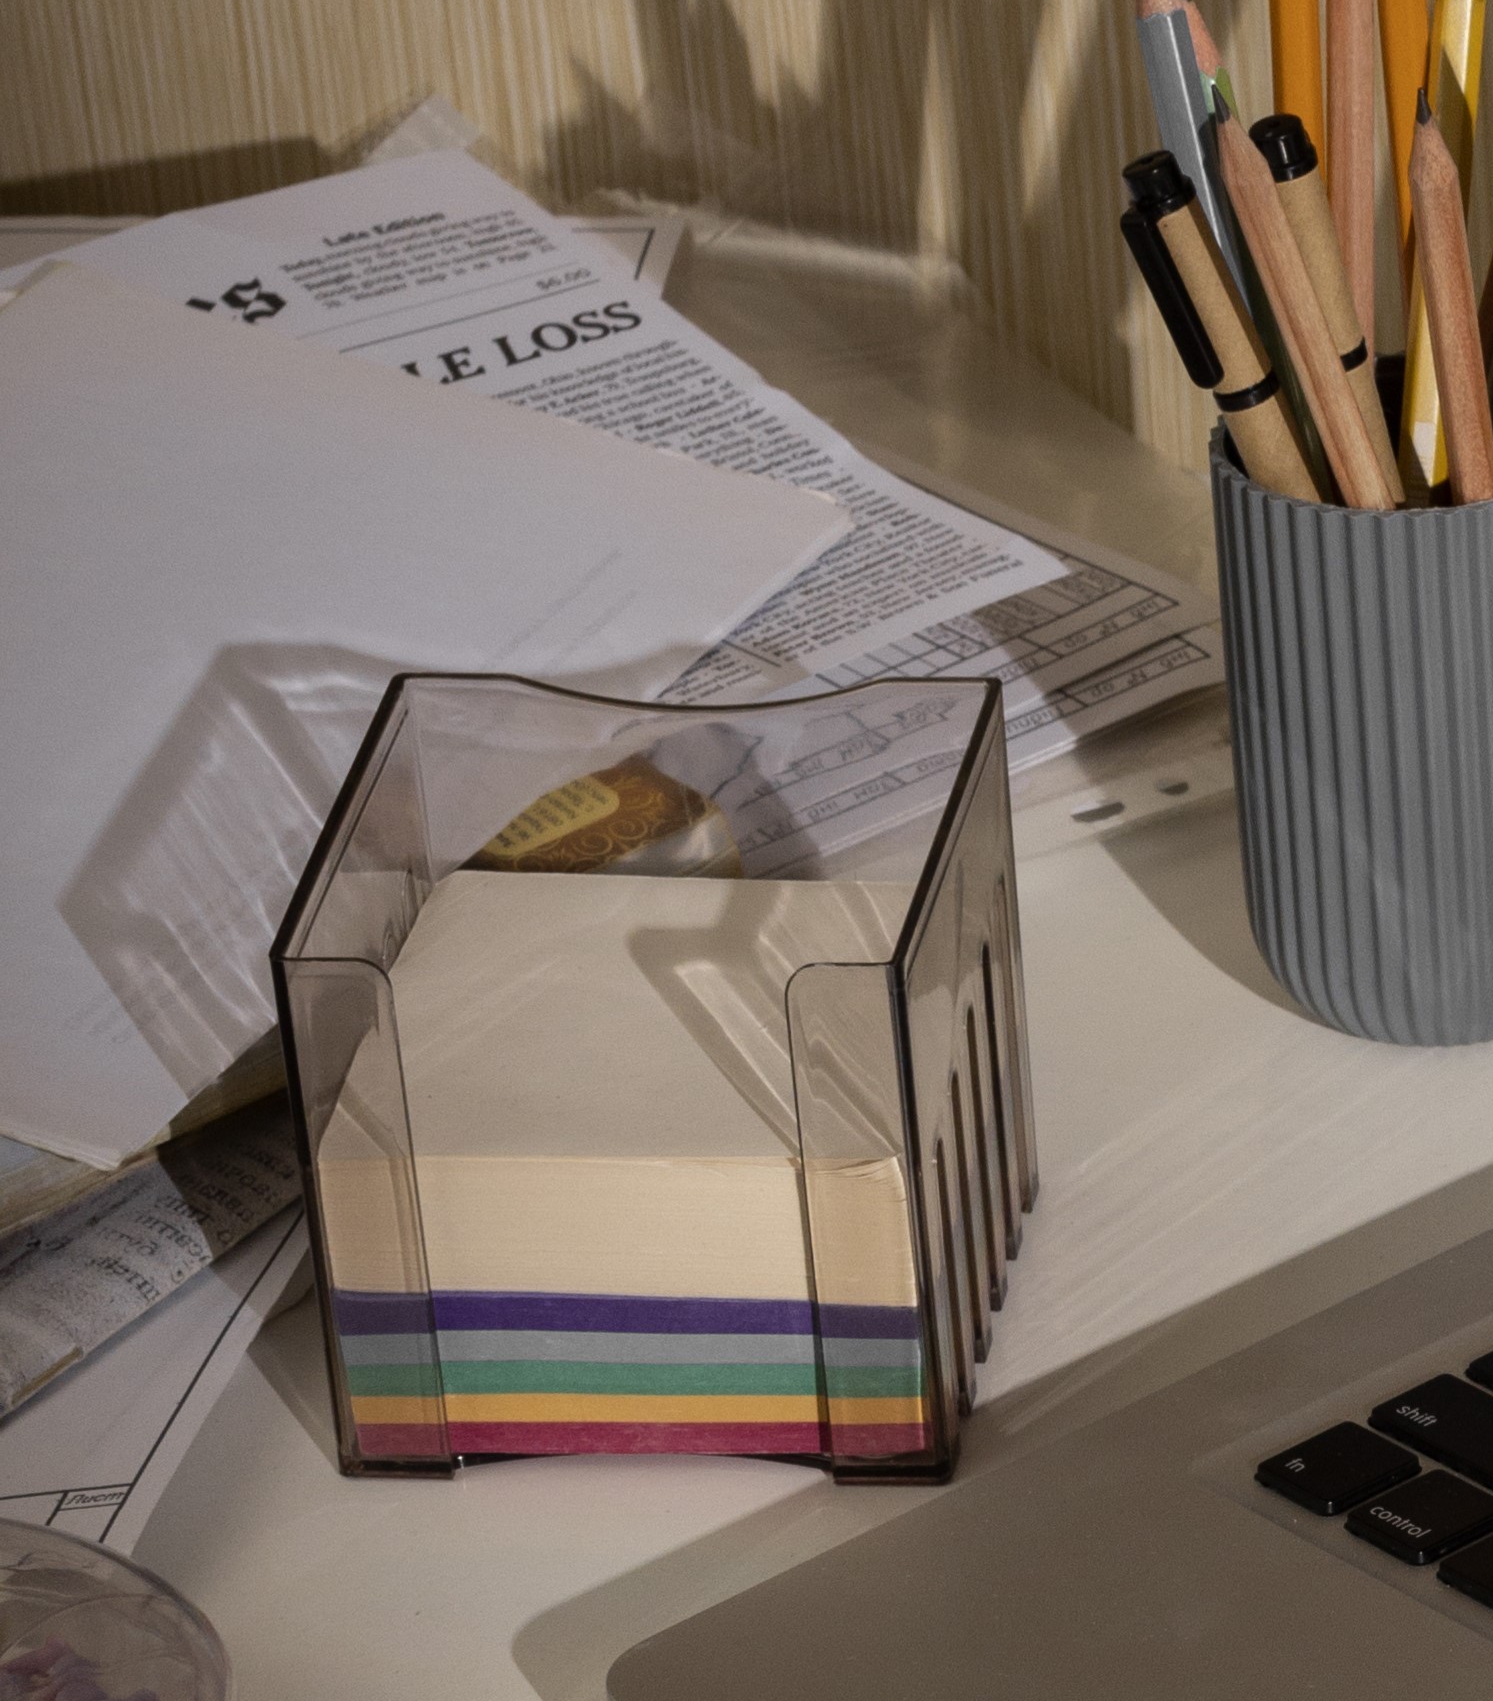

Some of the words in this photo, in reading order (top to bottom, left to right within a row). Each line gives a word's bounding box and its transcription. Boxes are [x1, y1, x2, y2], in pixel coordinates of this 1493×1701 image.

[493, 302, 641, 366] LOSS
[1396, 1406, 1437, 1426] shift
[1286, 1458, 1305, 1472] fn
[1370, 1507, 1431, 1538] control
